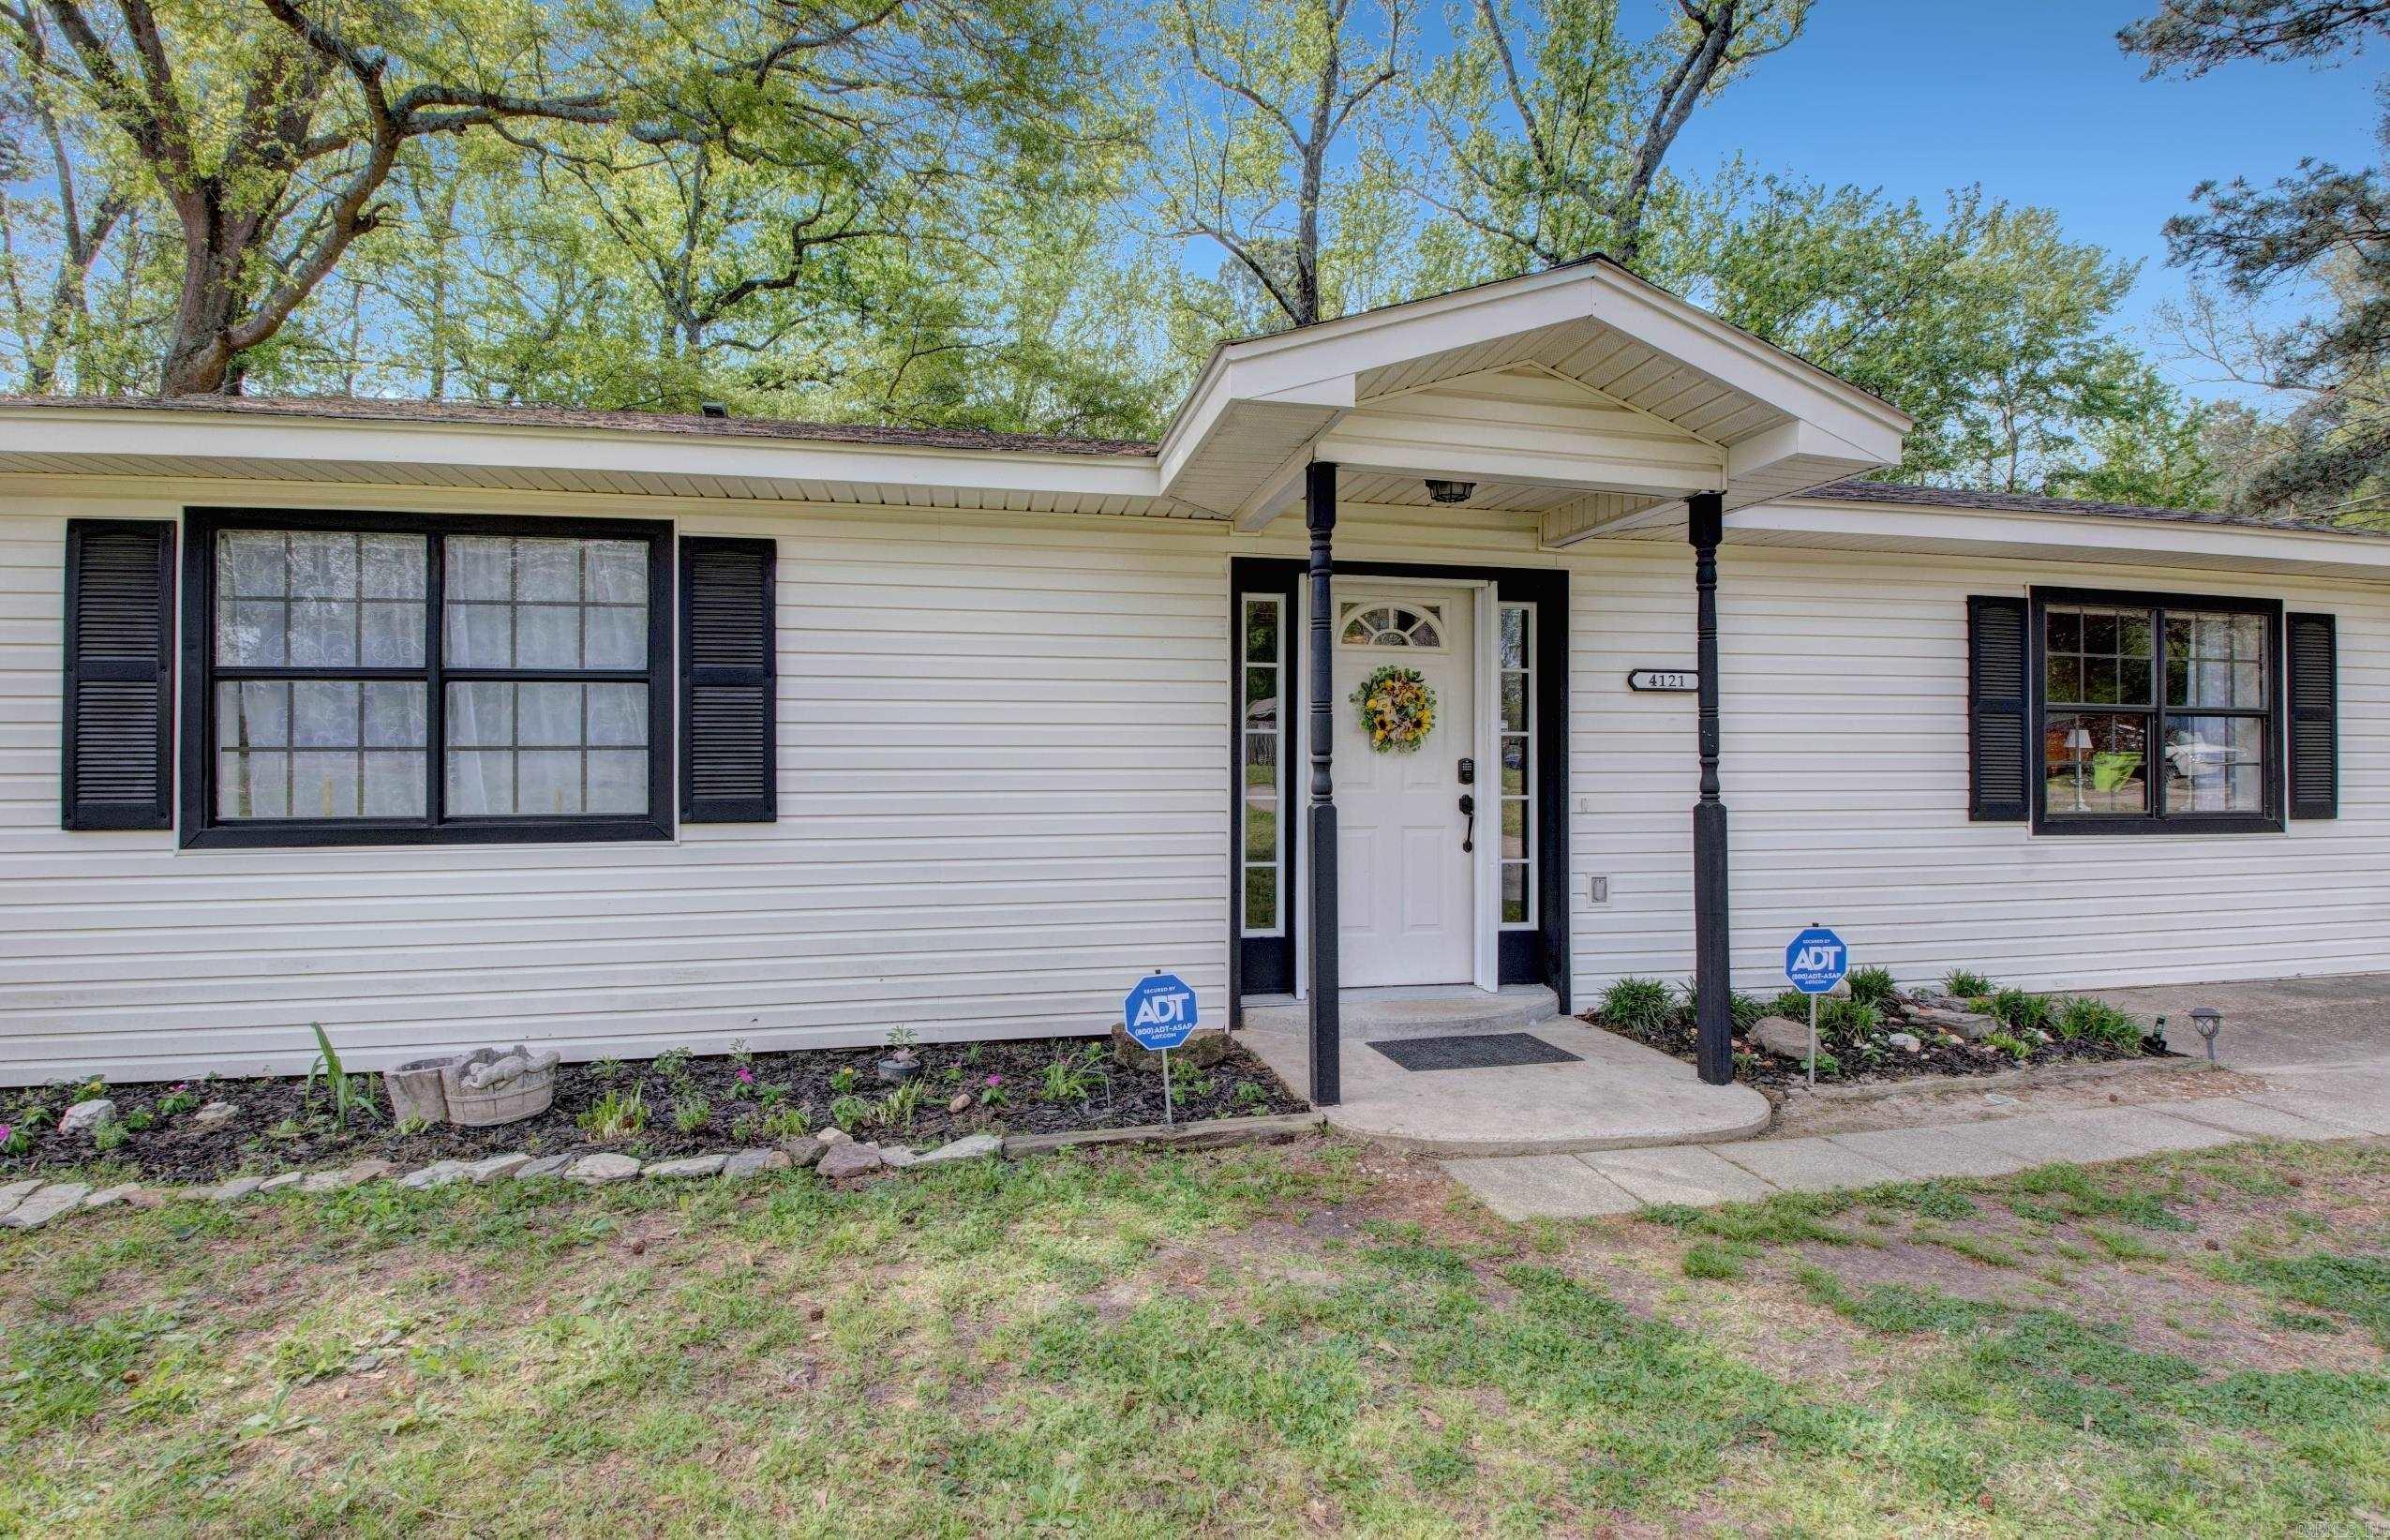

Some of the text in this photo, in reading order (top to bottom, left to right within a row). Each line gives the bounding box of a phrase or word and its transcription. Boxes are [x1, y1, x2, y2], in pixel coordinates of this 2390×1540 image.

[1650, 674, 1684, 687] 4121
[1790, 946, 1842, 972] ADT
[1133, 993, 1189, 1026] ADT
[1135, 1023, 1193, 1037] (800) ADT-ASAP
